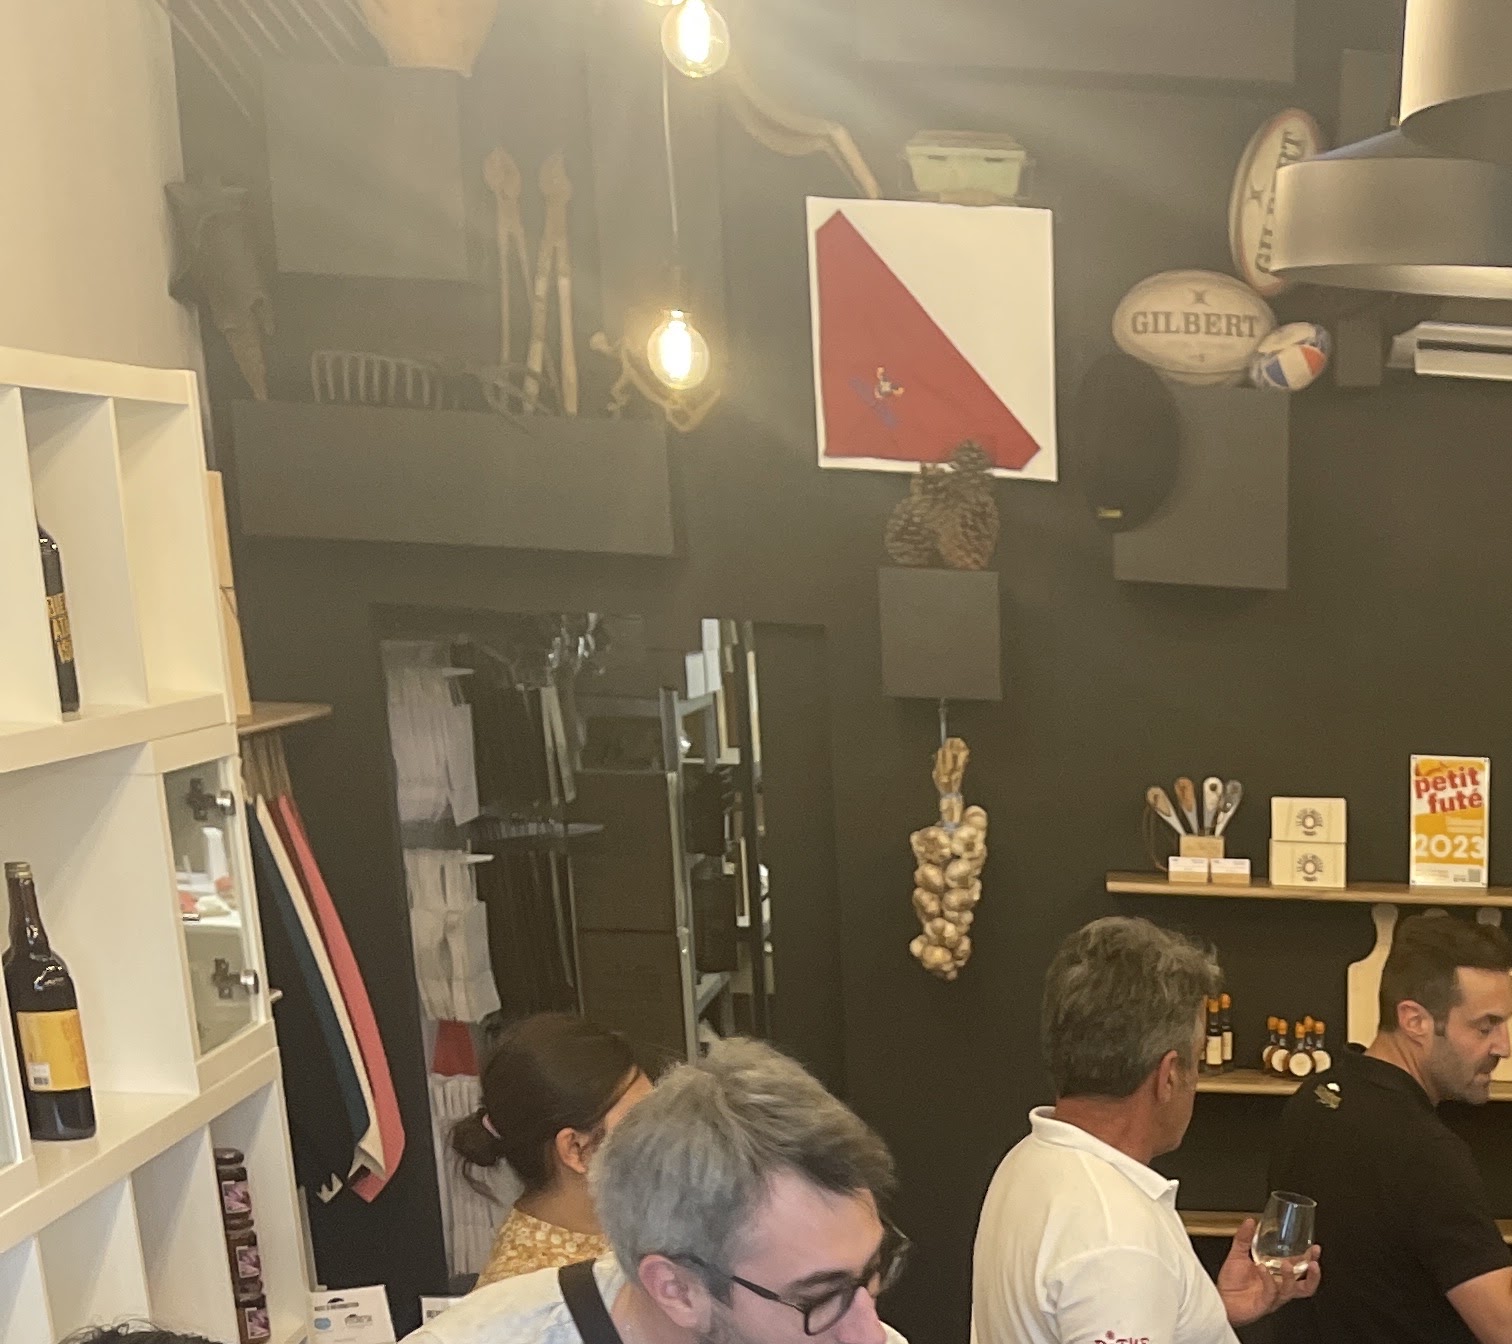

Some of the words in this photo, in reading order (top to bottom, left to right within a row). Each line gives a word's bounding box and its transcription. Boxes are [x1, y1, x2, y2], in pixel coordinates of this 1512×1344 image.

[1131, 310, 1257, 338] GILBERT
[1414, 766, 1480, 799] petit
[1427, 787, 1483, 814] futé
[1415, 834, 1484, 859] 2023
